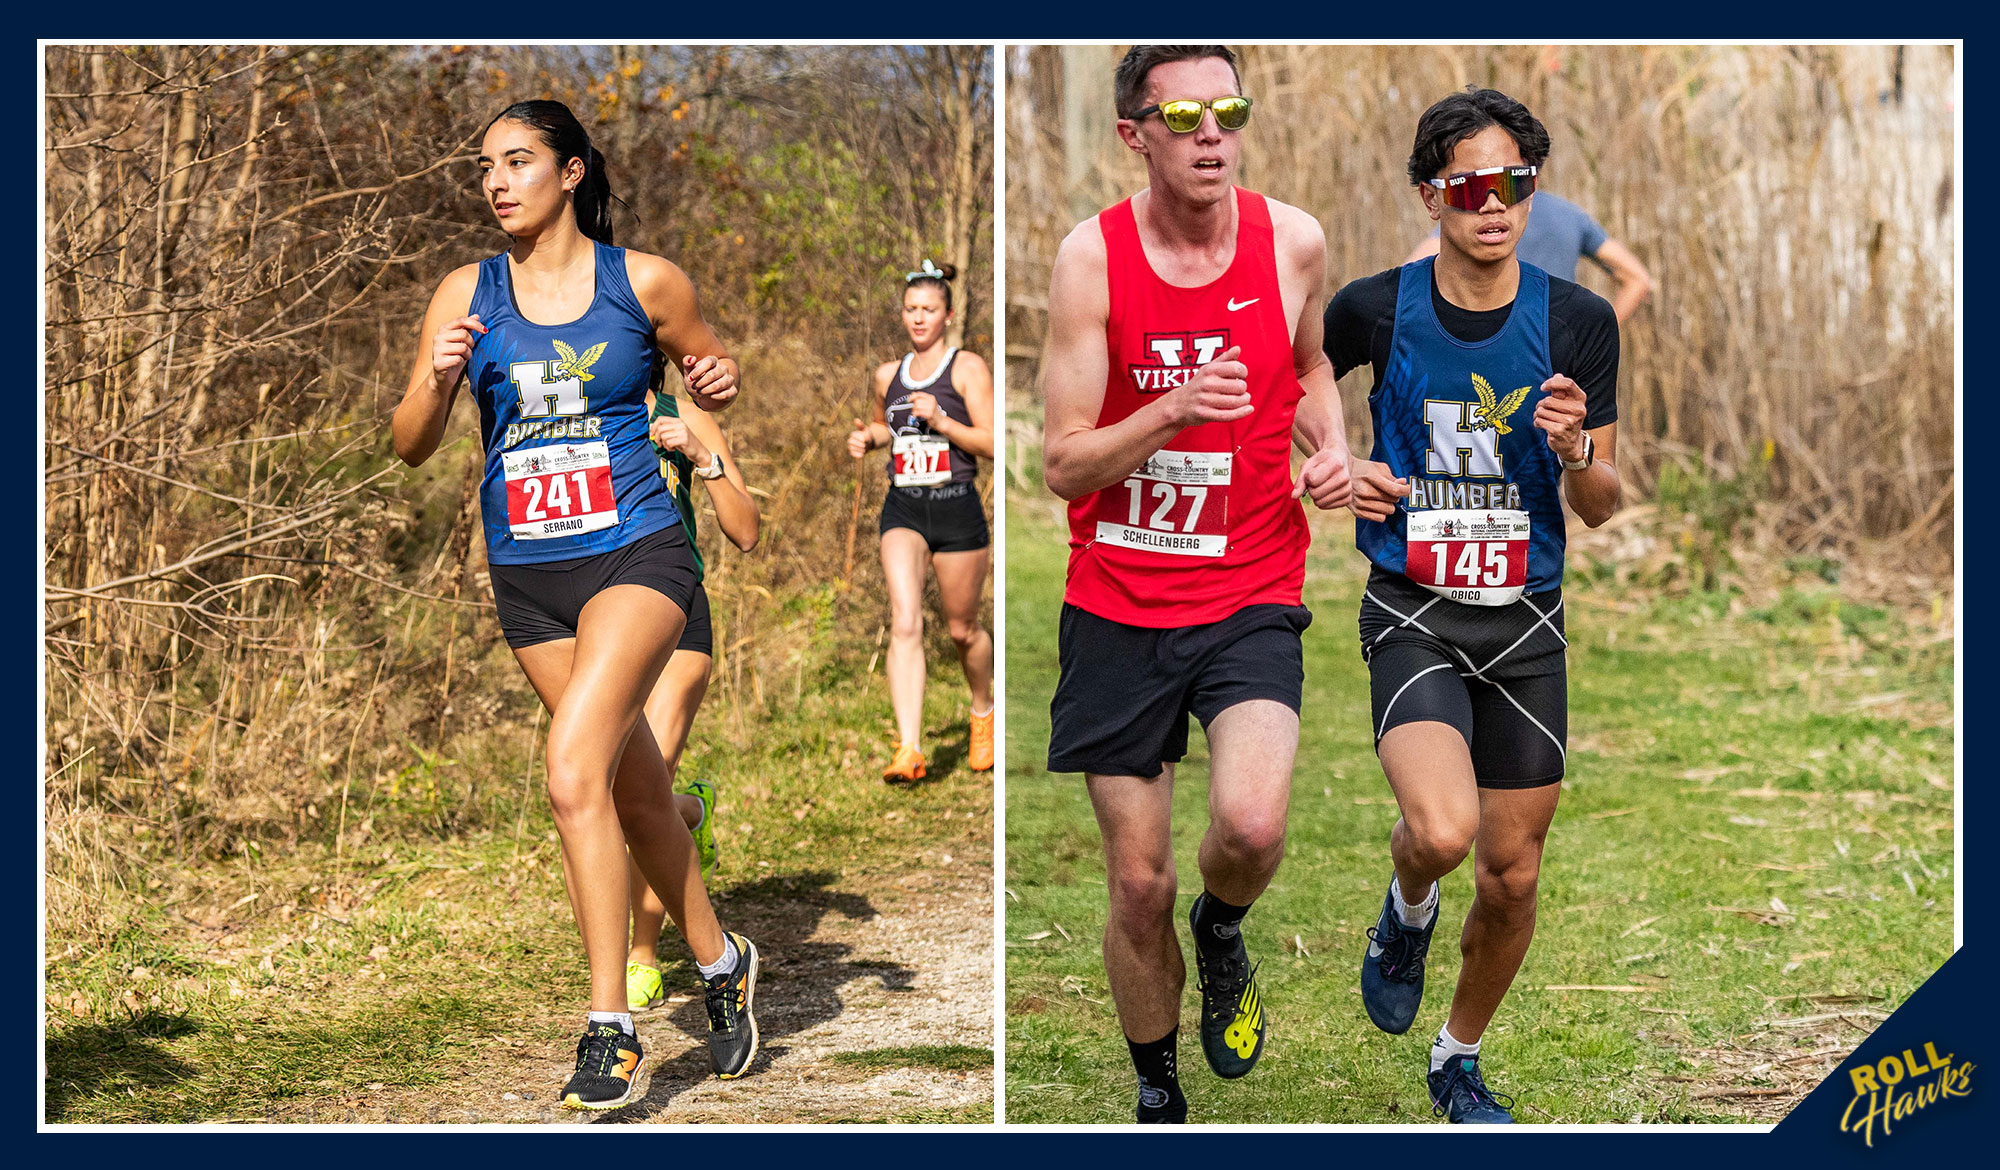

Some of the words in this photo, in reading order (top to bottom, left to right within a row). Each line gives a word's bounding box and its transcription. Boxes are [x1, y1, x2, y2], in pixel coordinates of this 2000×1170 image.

[1449, 176, 1466, 186] BUD
[1511, 168, 1530, 176] LIGHT
[510, 360, 588, 419] H
[1133, 368, 1200, 389] VIKI
[504, 415, 602, 448] HUMBER
[1424, 399, 1504, 478] H
[902, 450, 940, 474] 207
[523, 470, 592, 521] 241
[928, 483, 968, 500] NIKE
[1409, 476, 1522, 510] HUMBER
[1124, 479, 1208, 533] 127
[544, 518, 583, 534] SERRANO
[1123, 529, 1201, 549] SCHELLENBERG
[1430, 542, 1508, 587] 145
[1451, 590, 1481, 601] OBICO
